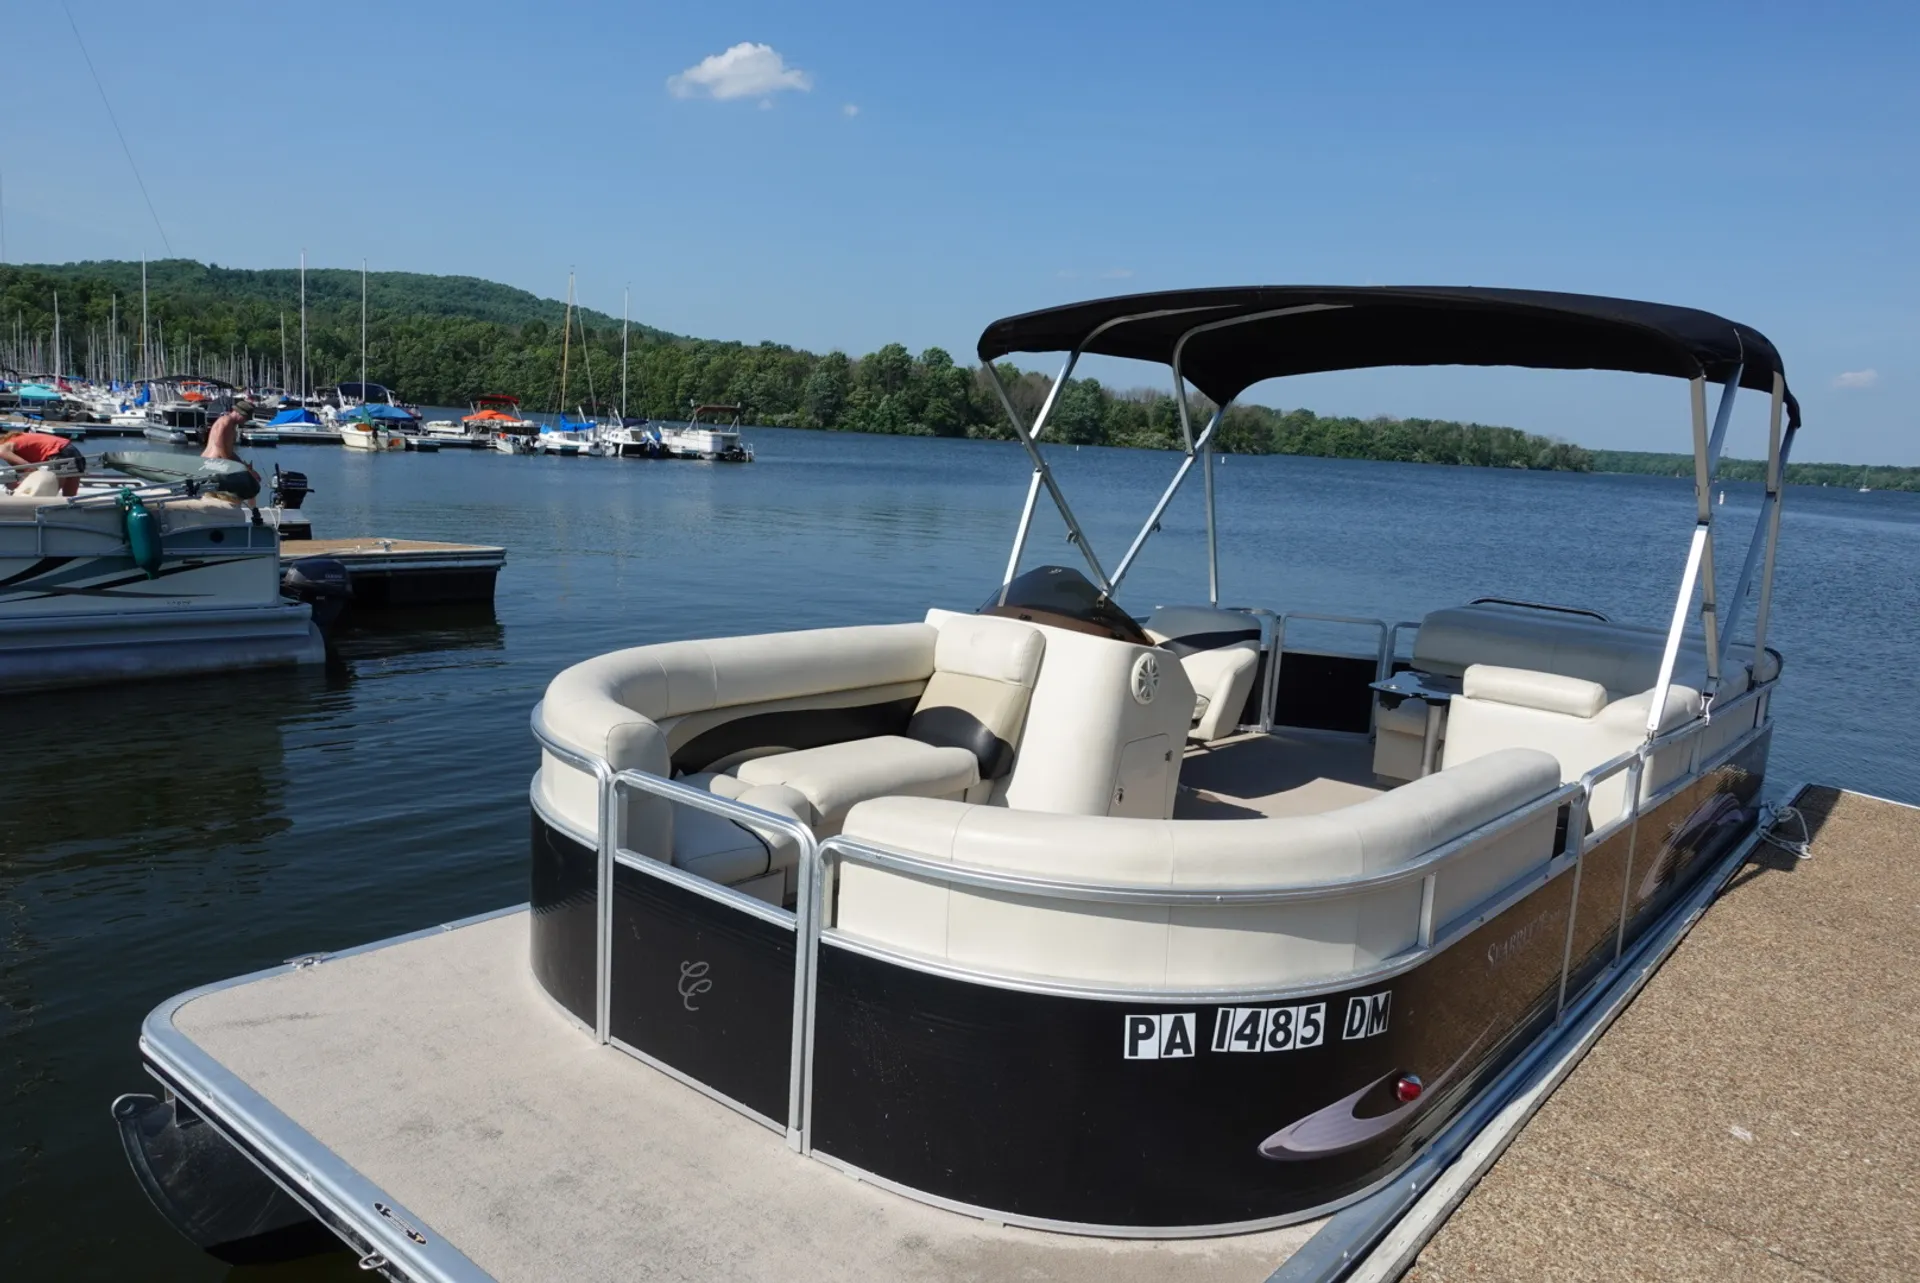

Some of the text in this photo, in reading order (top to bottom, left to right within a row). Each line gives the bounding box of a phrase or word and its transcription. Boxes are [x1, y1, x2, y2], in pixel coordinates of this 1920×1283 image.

[1127, 993, 1390, 1057] PA 1485 DM
